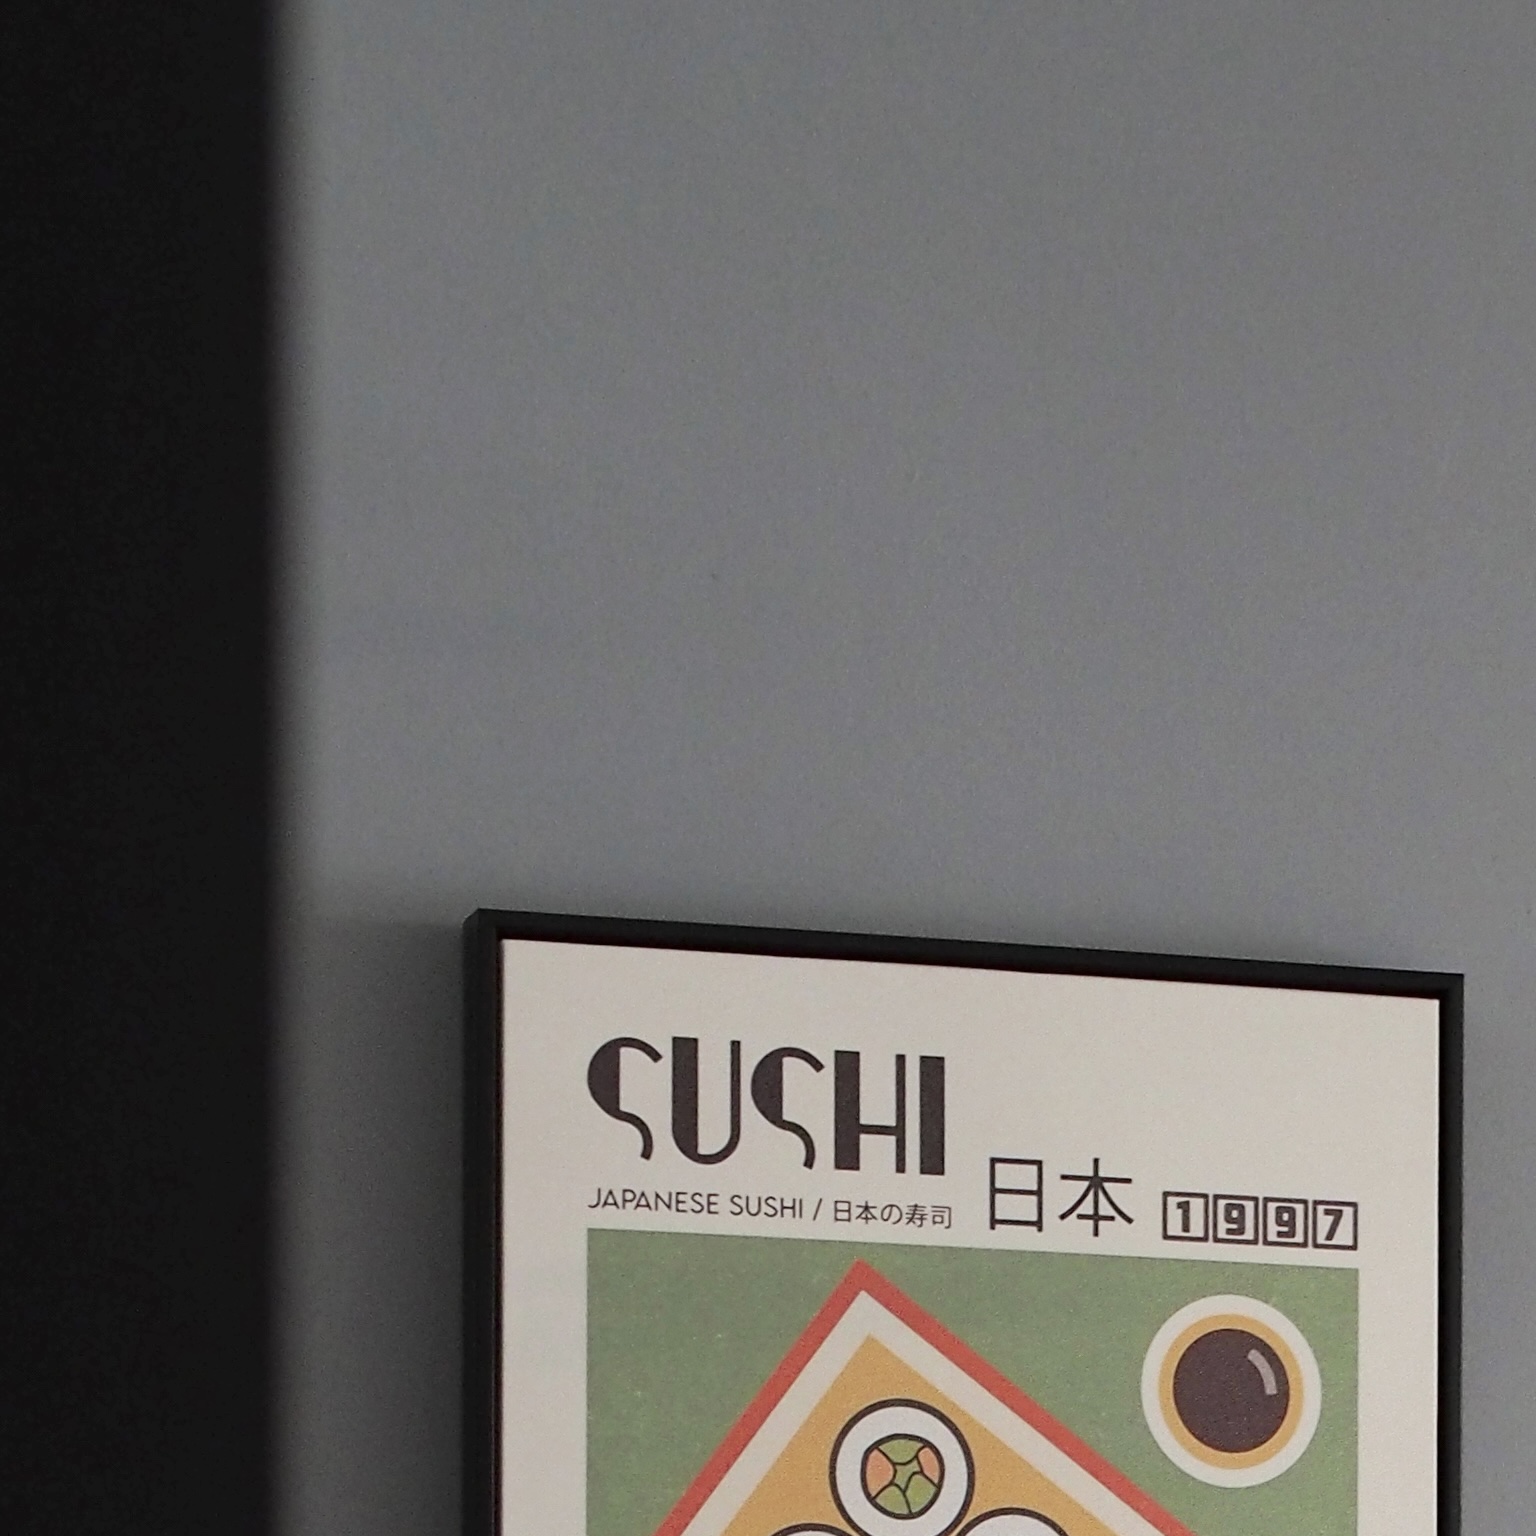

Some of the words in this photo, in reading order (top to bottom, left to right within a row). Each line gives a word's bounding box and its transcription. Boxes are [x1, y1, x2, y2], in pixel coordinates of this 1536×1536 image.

[587, 1036, 946, 1176] SUSHI
[588, 1187, 720, 1214] JAPANESE
[730, 1193, 803, 1219] SUSHI
[834, 1199, 953, 1229] 日本の寿司
[990, 1157, 1134, 1237] 日本
